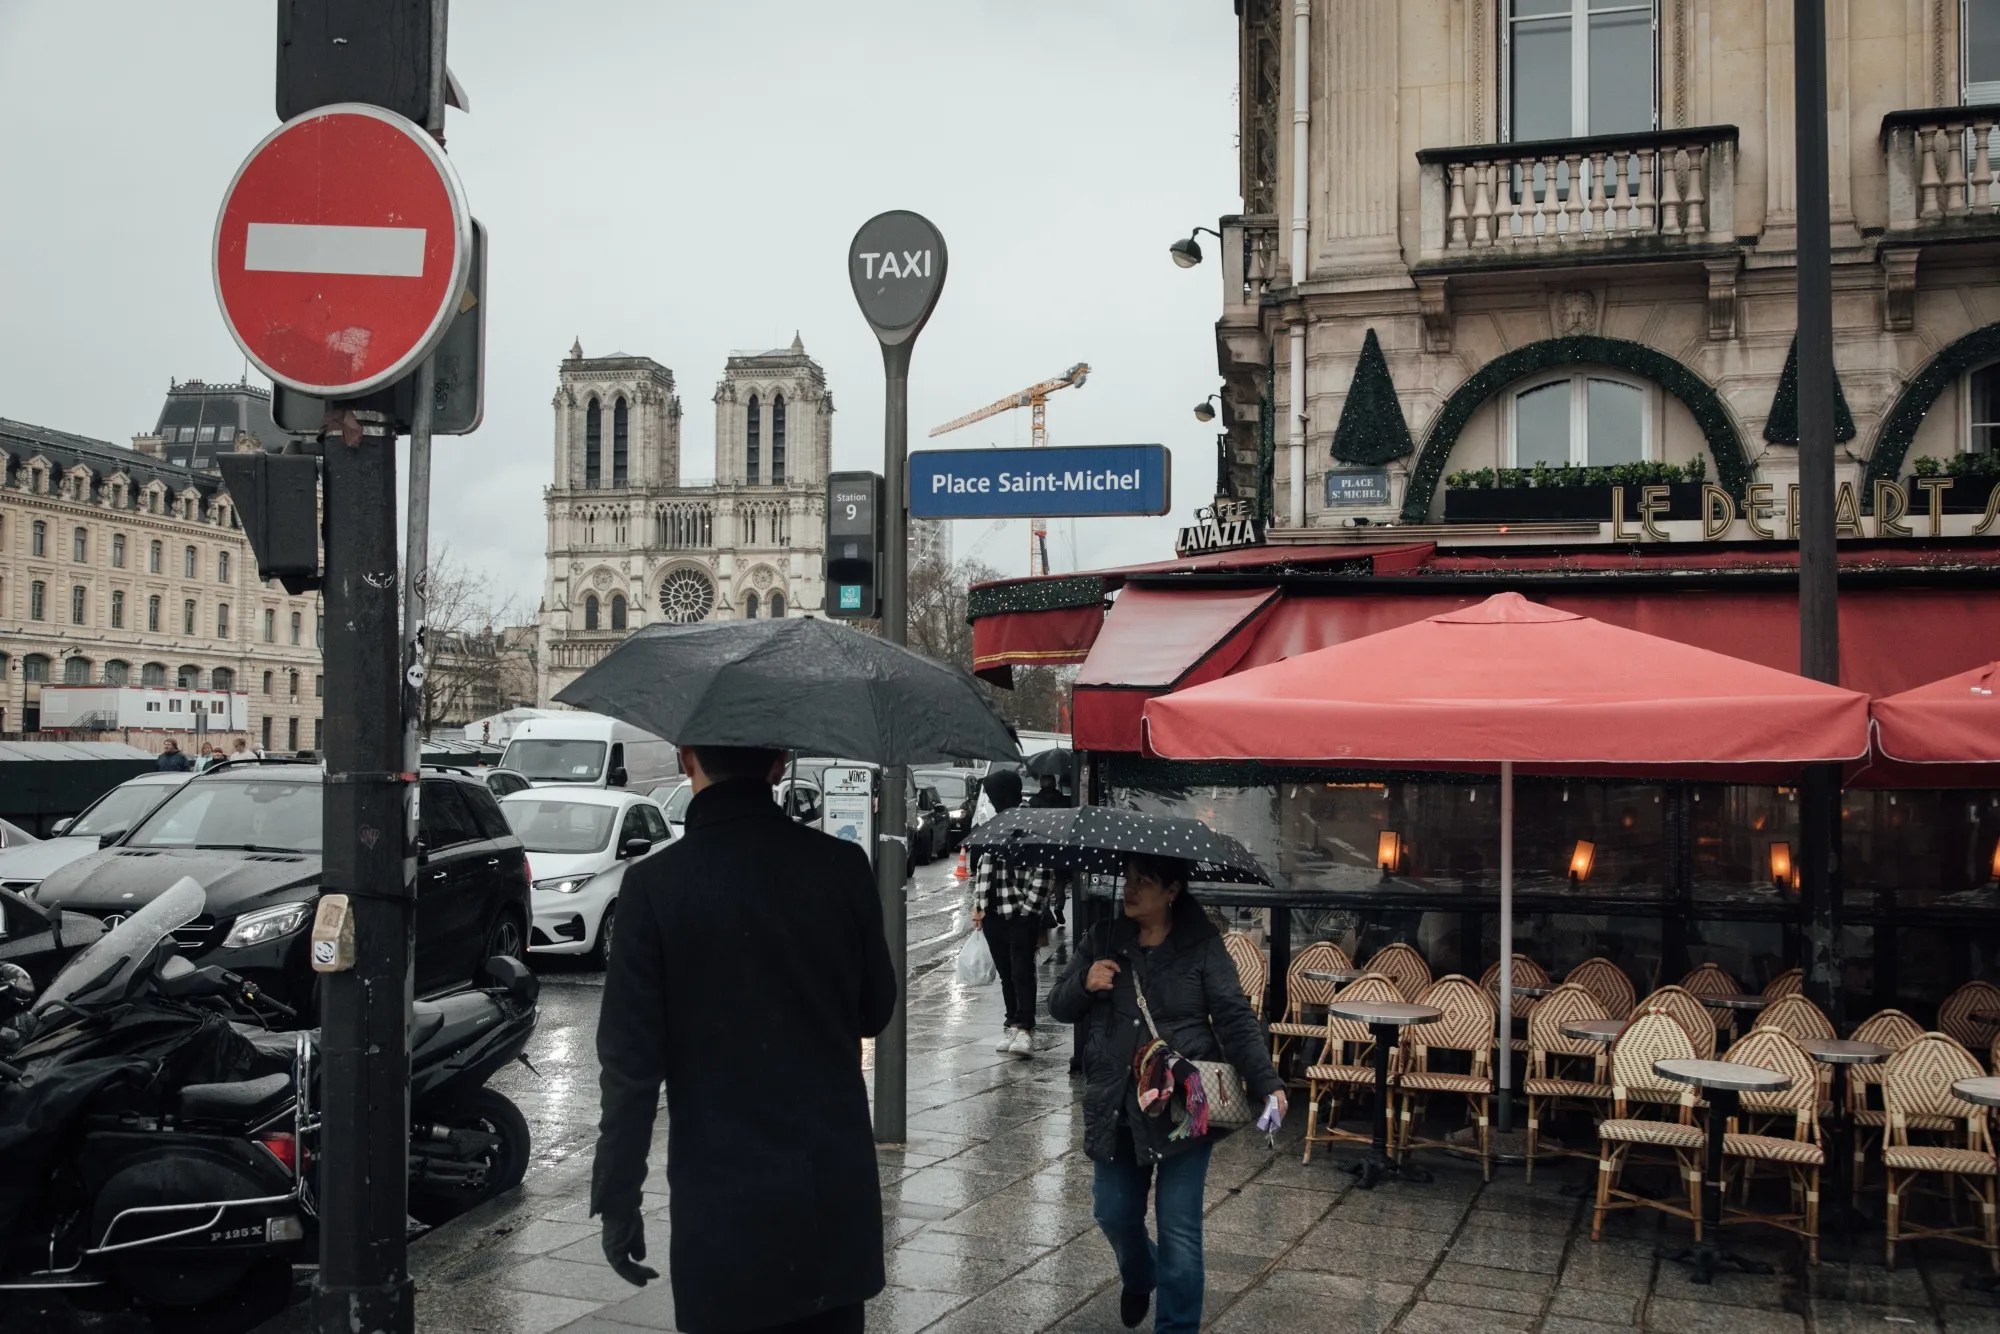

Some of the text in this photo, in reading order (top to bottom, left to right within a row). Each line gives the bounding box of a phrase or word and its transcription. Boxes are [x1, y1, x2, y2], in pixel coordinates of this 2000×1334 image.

[859, 249, 931, 279] TAXI
[932, 469, 1140, 494] Place Saint-Michel
[1341, 478, 1374, 488] PLACE
[837, 493, 867, 502] Station
[1343, 489, 1384, 499] MICHEL
[846, 504, 857, 520] 9
[1612, 486, 1671, 543] LE
[1176, 518, 1256, 552] LAVAZZA
[211, 1226, 263, 1241] P 125 X
